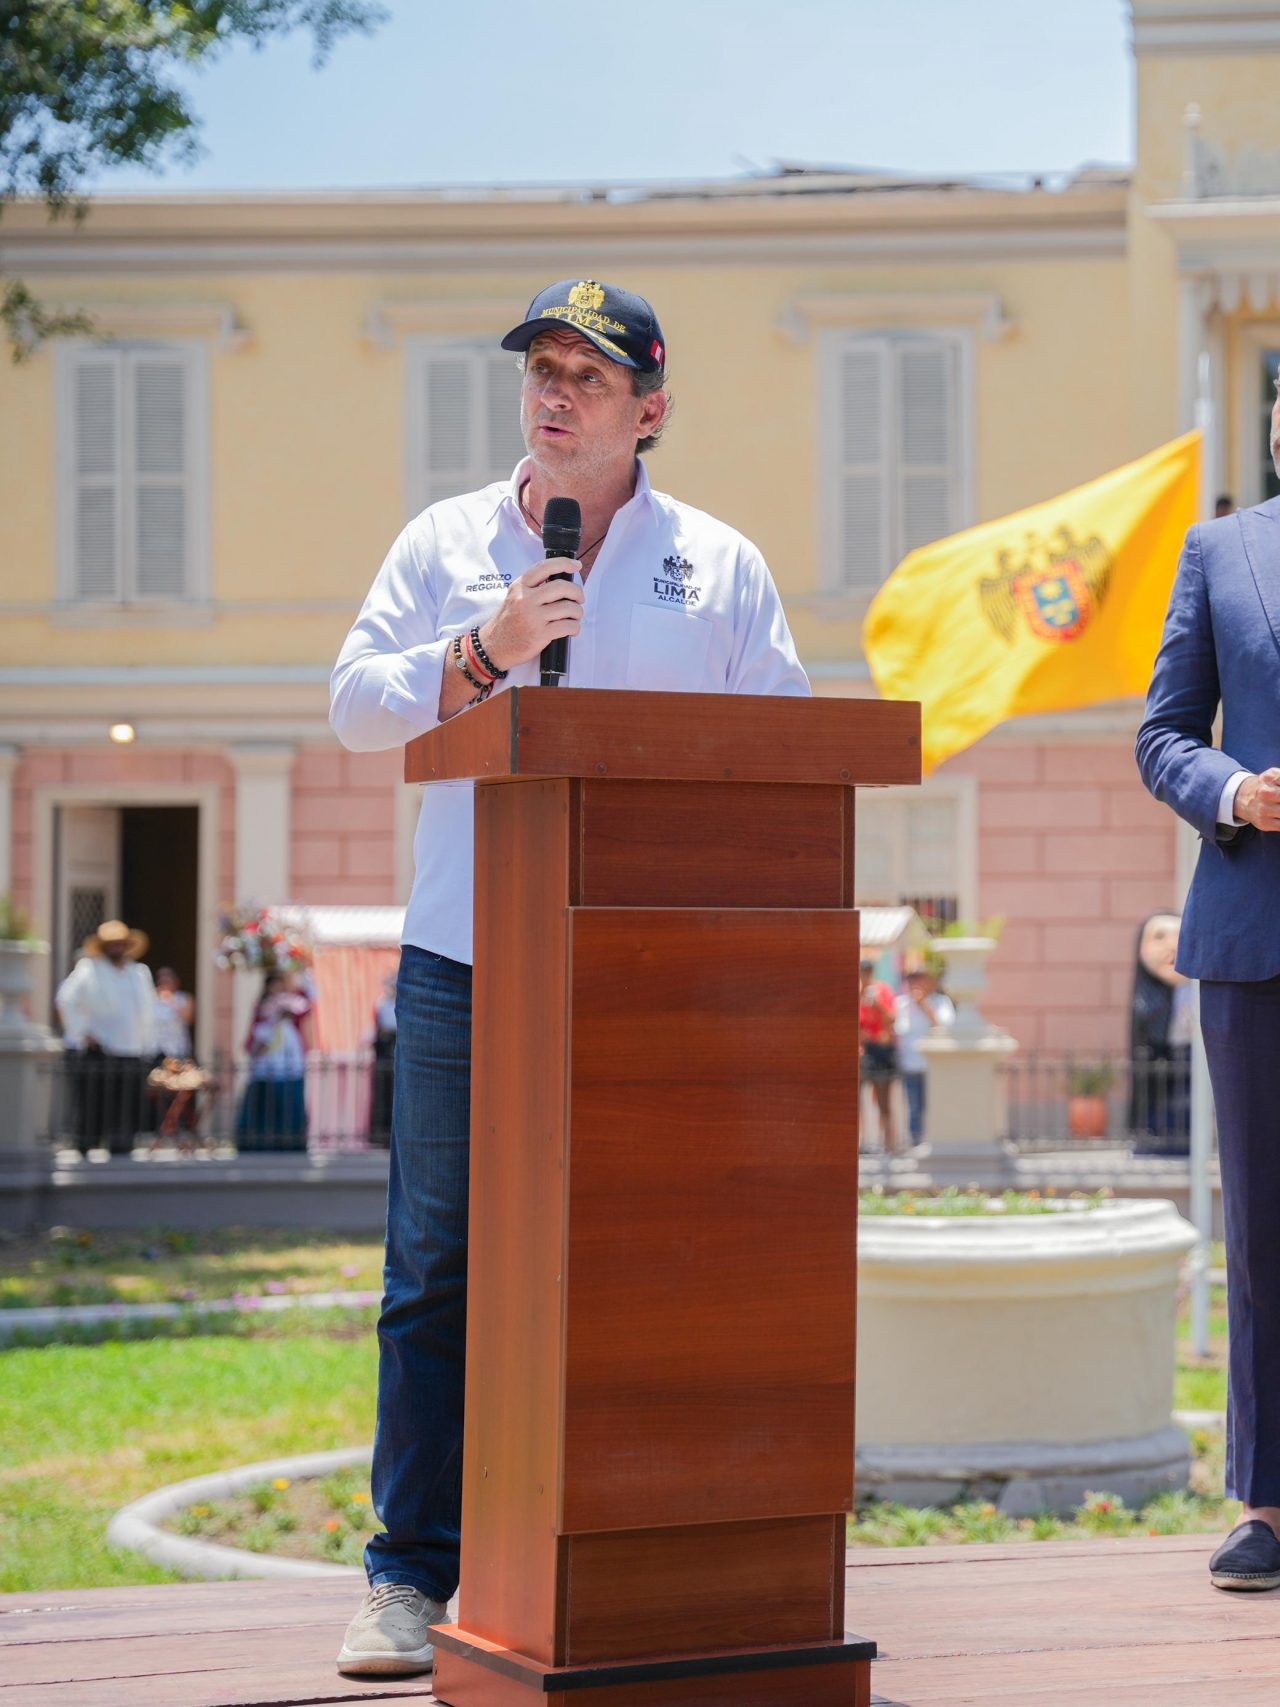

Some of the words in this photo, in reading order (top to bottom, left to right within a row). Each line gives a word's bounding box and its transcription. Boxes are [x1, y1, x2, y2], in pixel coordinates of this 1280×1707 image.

[542, 306, 610, 324] MUNICIPALIDAD
[613, 321, 626, 333] DE
[479, 573, 512, 581] RENZO
[465, 582, 512, 592] REGGIAR
[654, 582, 700, 601] LIMA
[658, 595, 697, 606] ALCALDE
